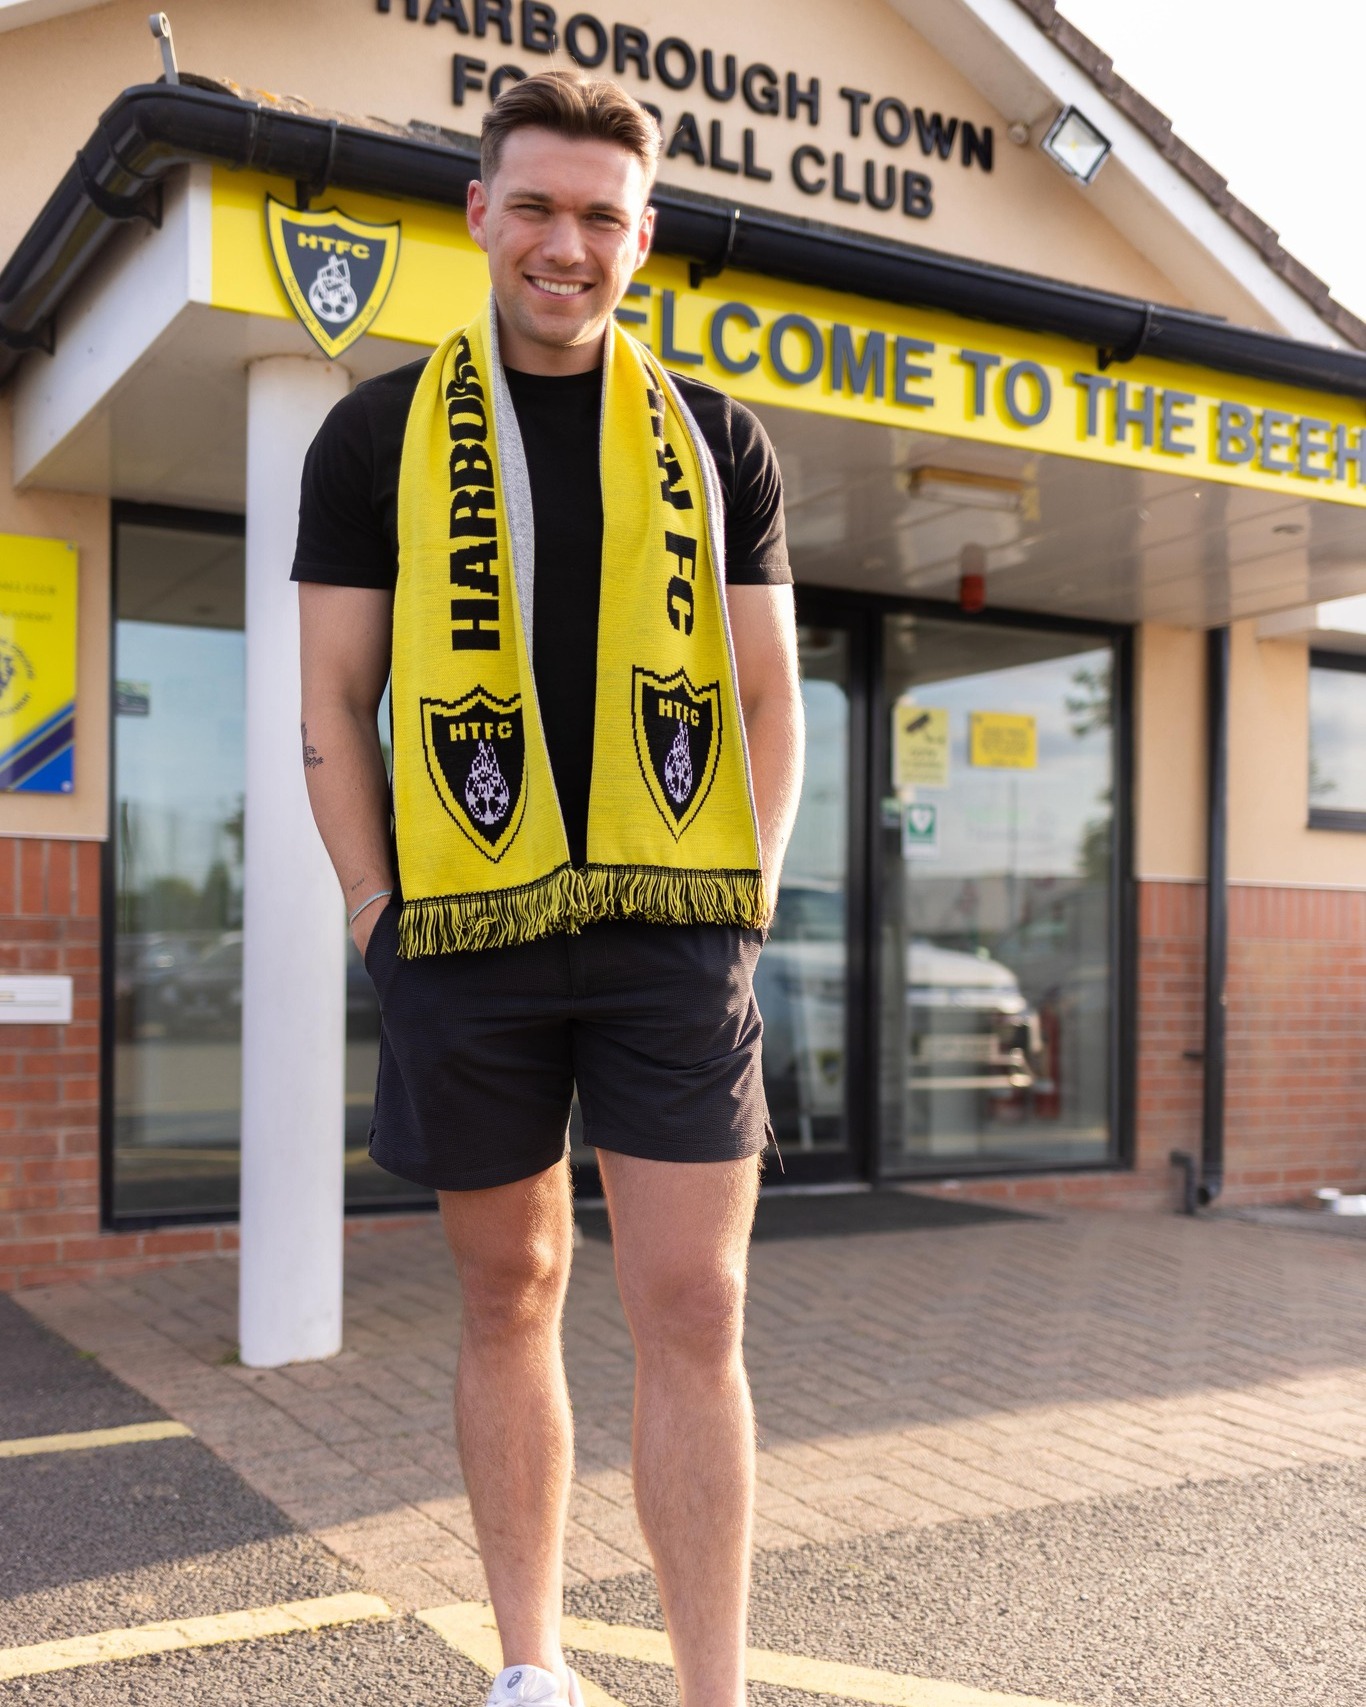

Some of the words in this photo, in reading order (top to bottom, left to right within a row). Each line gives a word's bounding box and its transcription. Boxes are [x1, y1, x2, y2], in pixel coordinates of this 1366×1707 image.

[839, 86, 993, 174] TOWN
[791, 144, 934, 219] CLUB
[297, 232, 370, 260] HTFC
[960, 348, 1051, 427] TO
[1074, 372, 1196, 455] THE
[664, 531, 698, 637] FC
[449, 721, 513, 742] HTFC
[658, 697, 700, 727] HTFC
